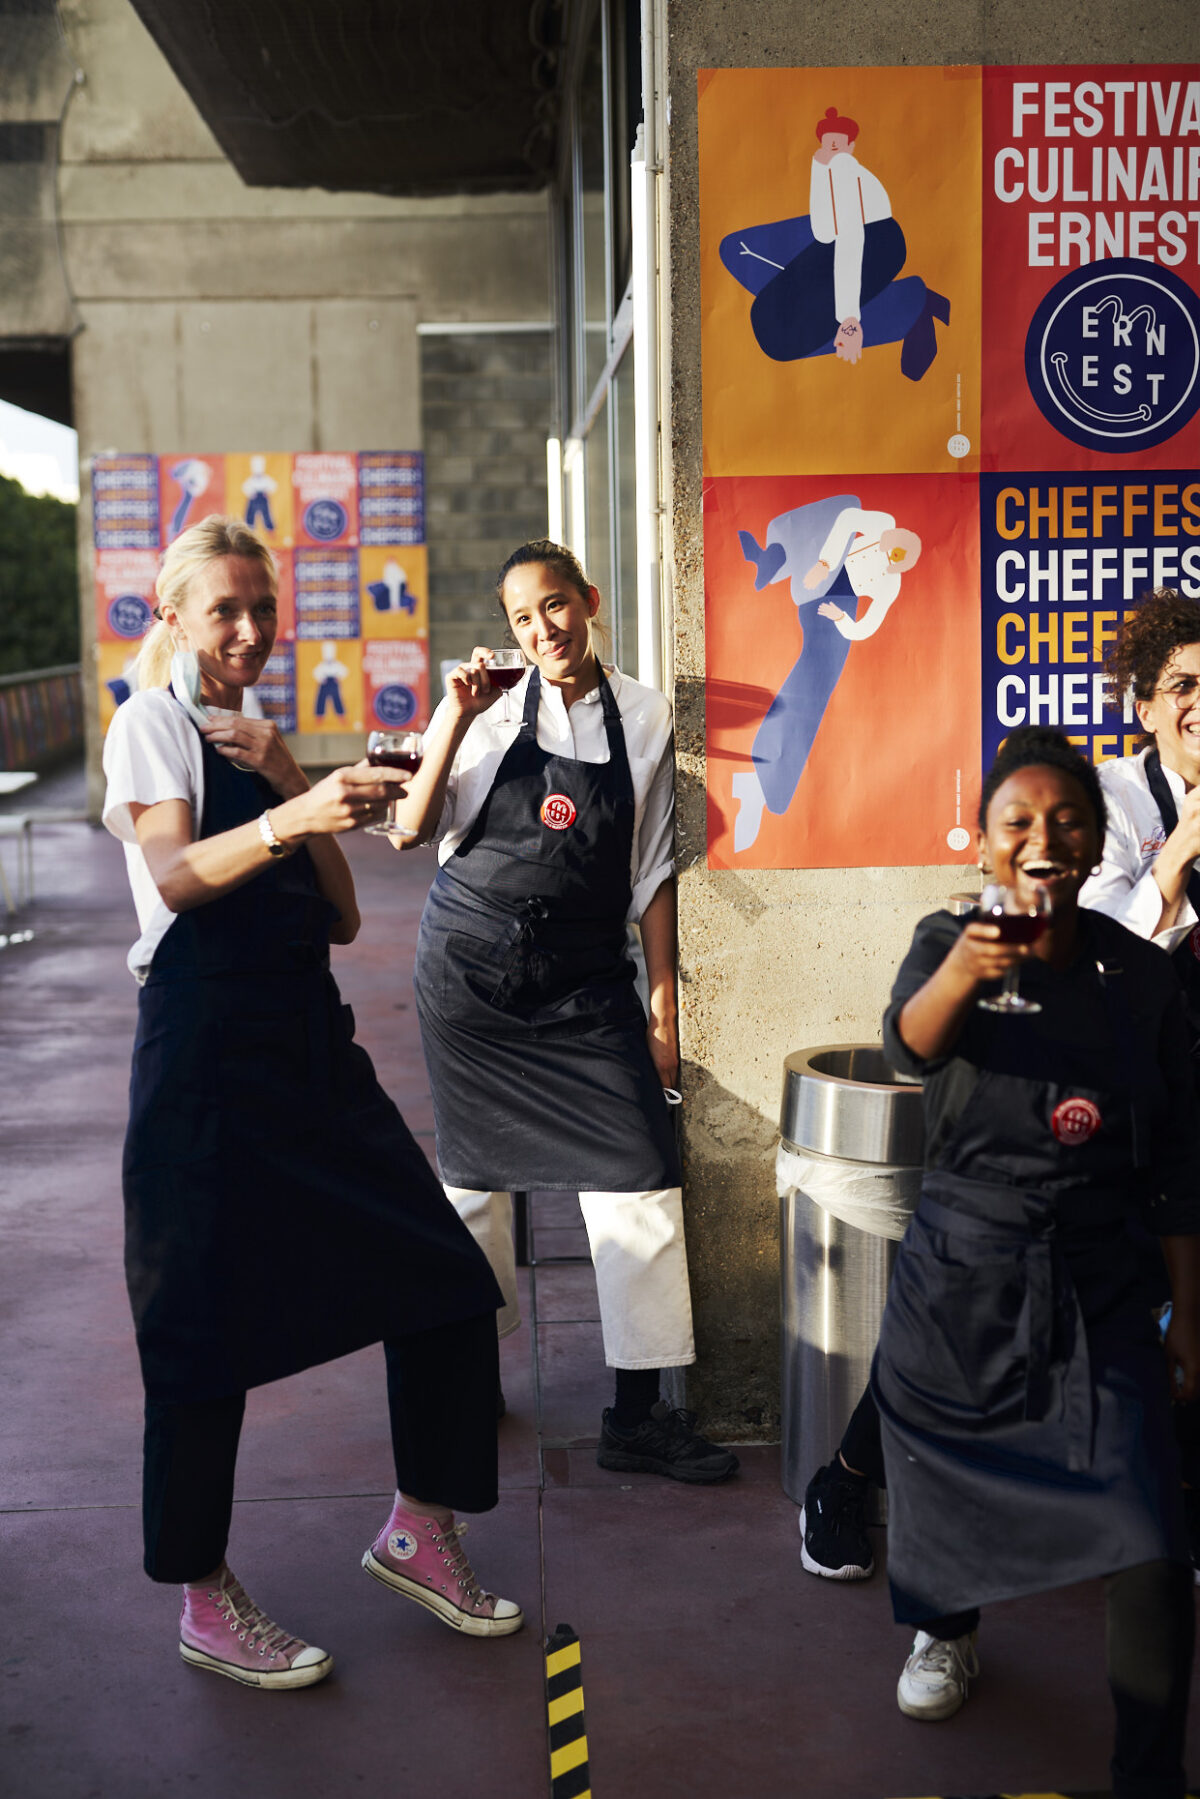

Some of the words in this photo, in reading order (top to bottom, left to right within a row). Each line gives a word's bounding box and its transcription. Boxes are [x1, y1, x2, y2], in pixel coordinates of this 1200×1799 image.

[1012, 81, 1200, 138] FESTIVA
[1082, 355, 1165, 405] EST
[995, 483, 1200, 541] CHEFFES
[995, 546, 1200, 604] CHEFFES
[996, 610, 1138, 666] CHEF
